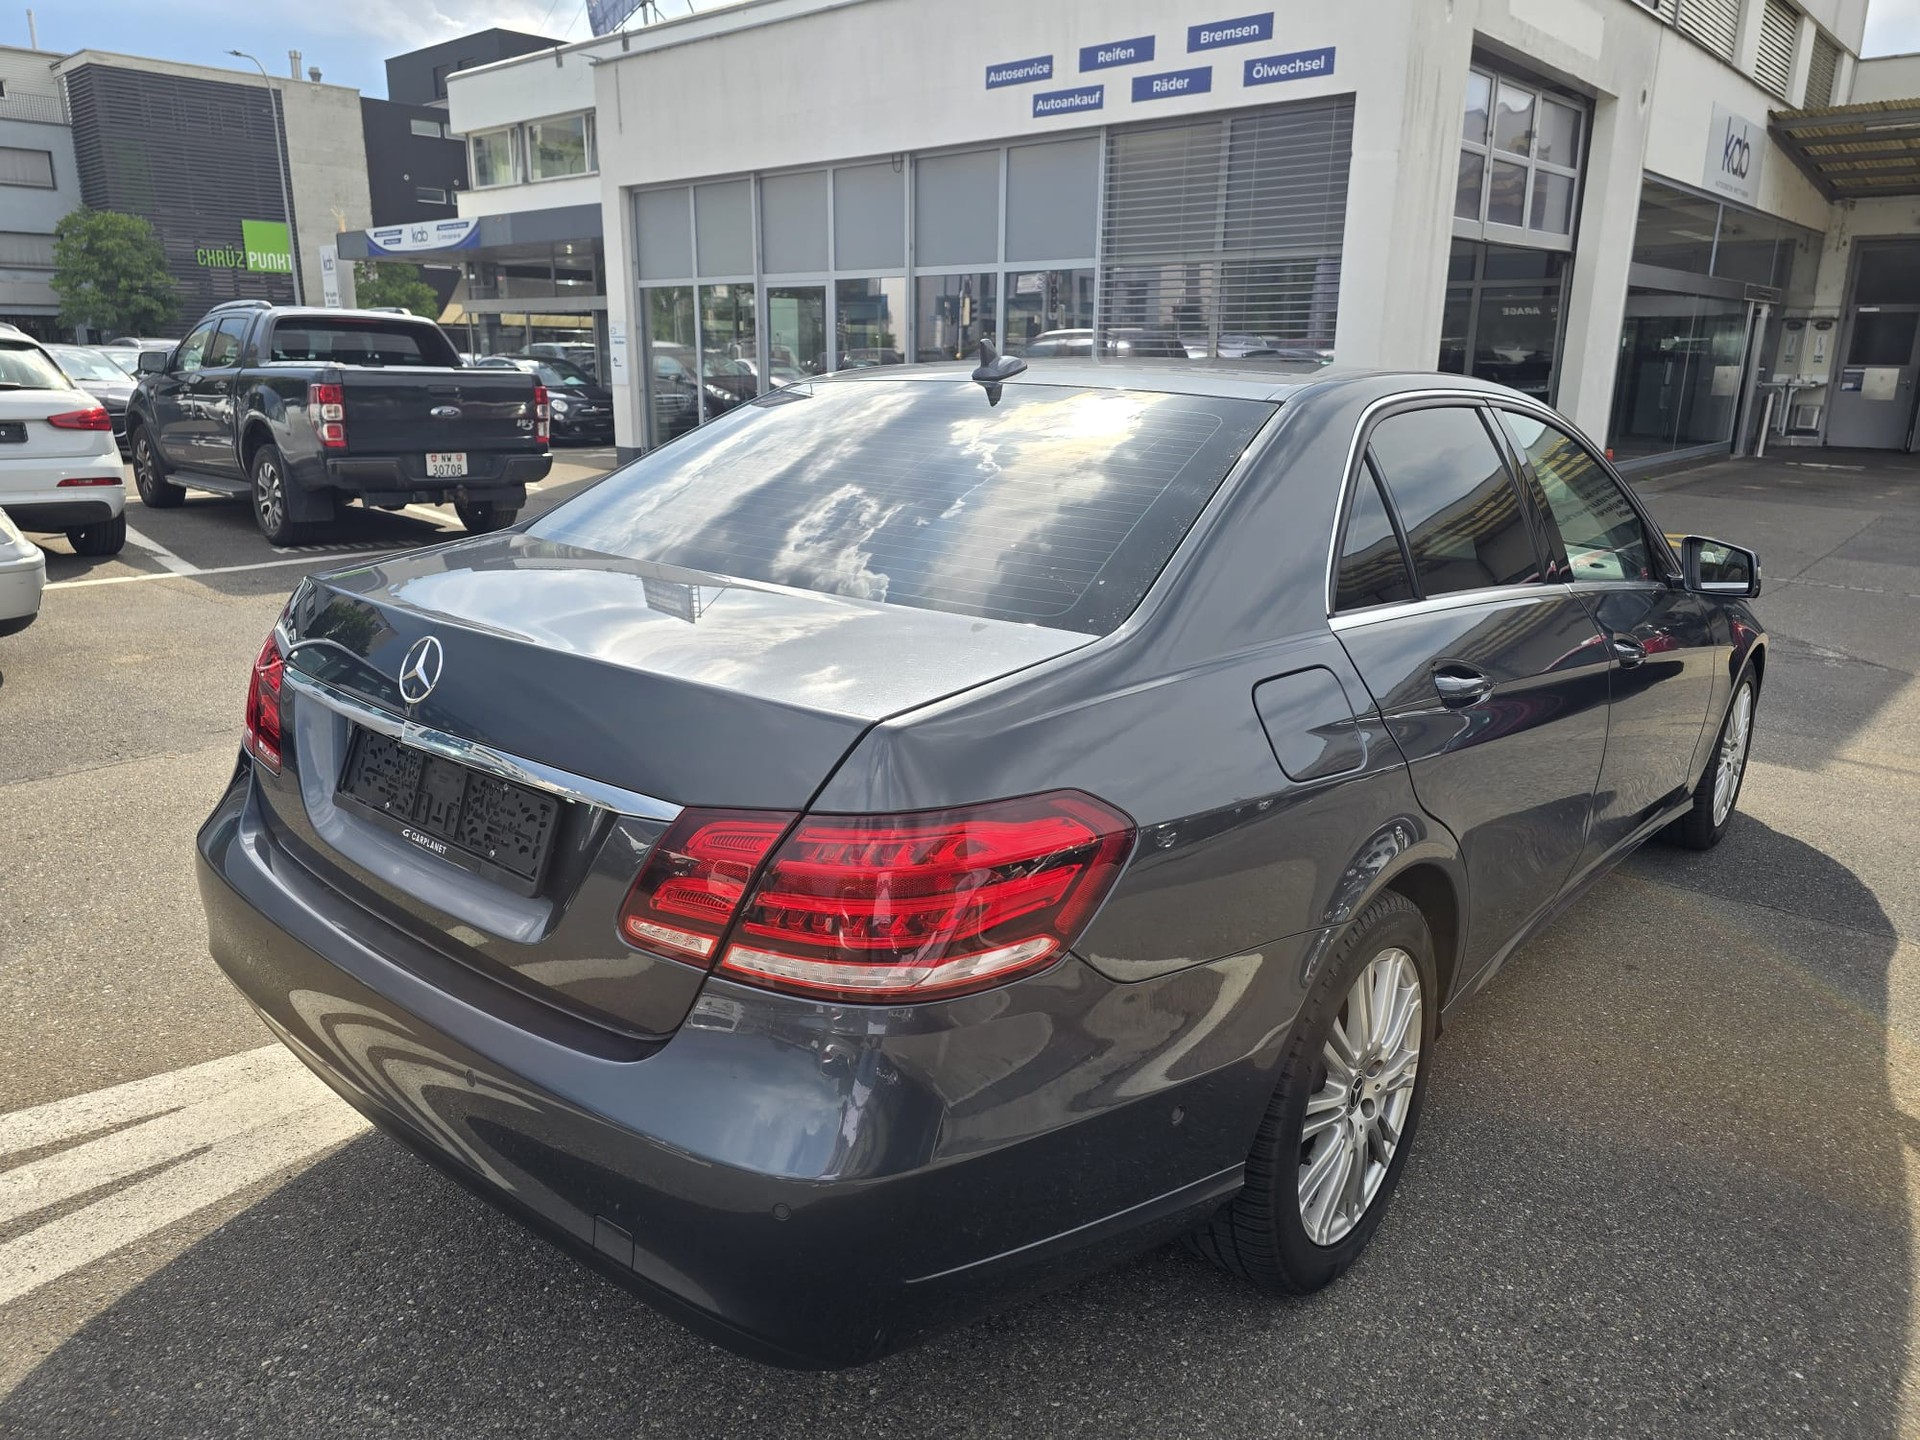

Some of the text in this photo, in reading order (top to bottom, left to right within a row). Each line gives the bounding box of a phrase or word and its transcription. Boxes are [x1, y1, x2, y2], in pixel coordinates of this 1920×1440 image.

[1200, 24, 1259, 44] Bremsen
[1097, 47, 1135, 63] Reifen
[989, 63, 1050, 83] Autoservice
[1252, 55, 1325, 79] Ölwechsel
[1152, 77, 1190, 93] Räder
[1036, 91, 1101, 112] Autoankauf
[197, 245, 293, 270] CHRÜZ PUNKT
[441, 454, 452, 462] NW
[433, 464, 462, 475] 30708
[411, 832, 447, 855] CARPLANET
